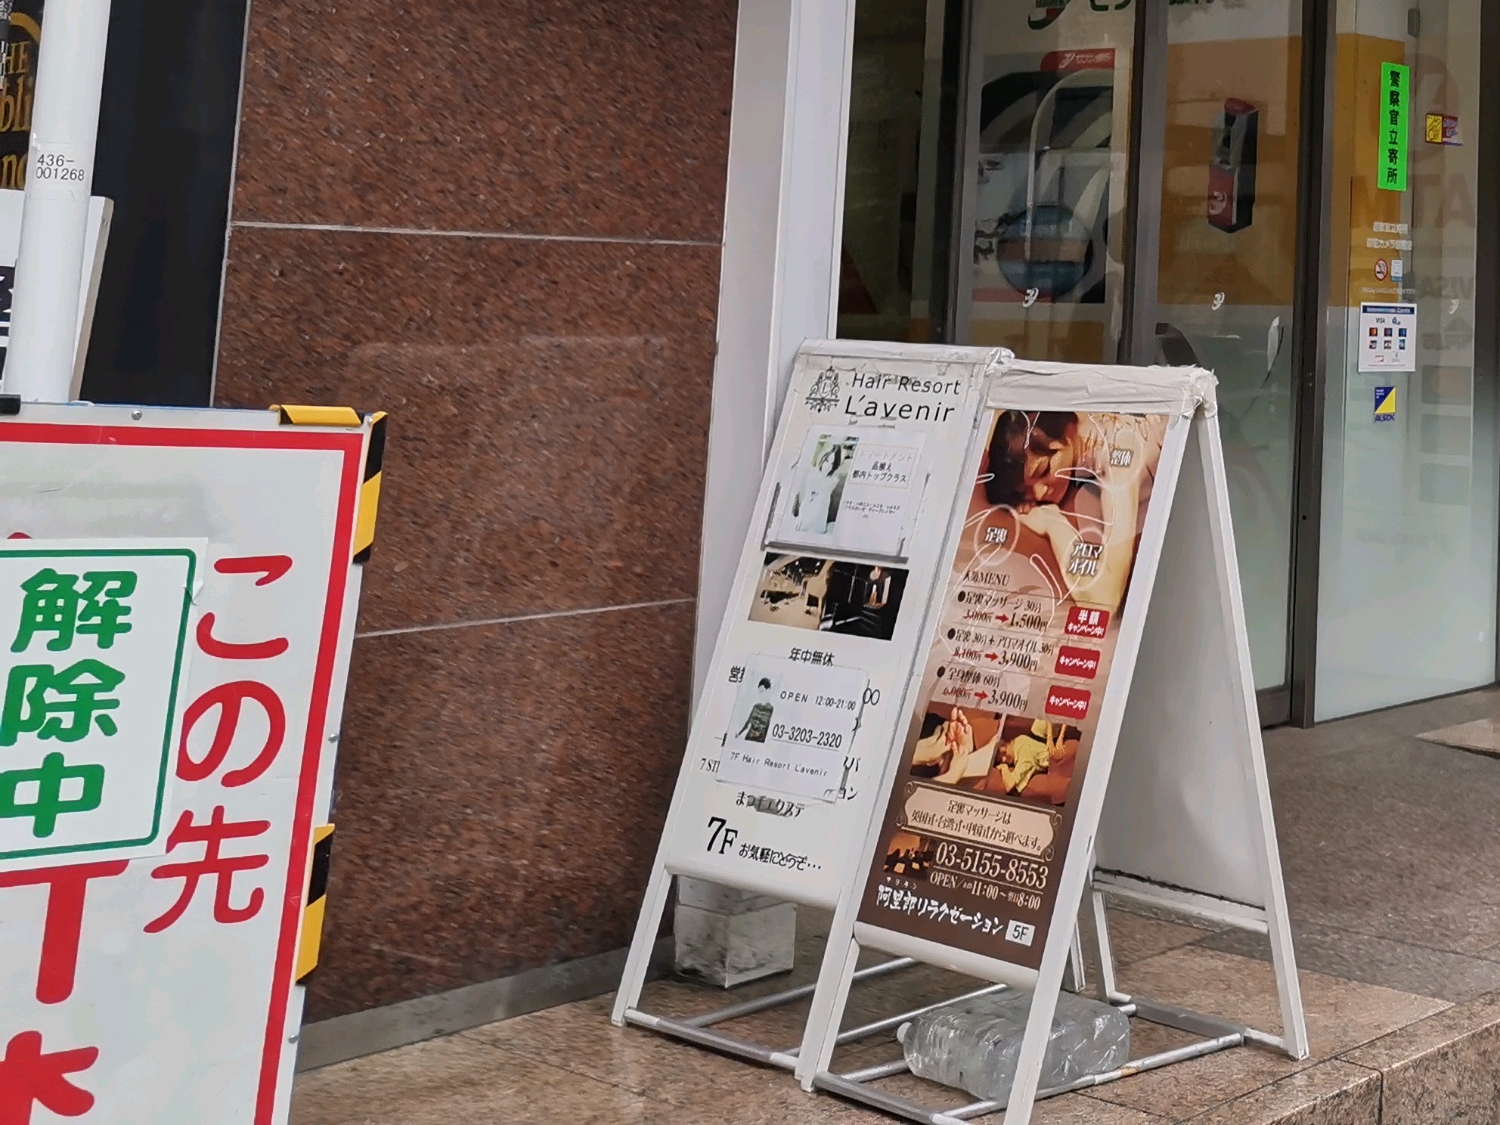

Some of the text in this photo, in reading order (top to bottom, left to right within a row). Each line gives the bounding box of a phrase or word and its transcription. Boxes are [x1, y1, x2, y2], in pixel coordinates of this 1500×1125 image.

[1385, 70, 1401, 185] 警察官立寄所
[37, 154, 75, 167] 436-
[35, 166, 85, 181] 001268
[852, 373, 961, 395] Hair Resort
[844, 395, 956, 422] L'avenir
[1072, 542, 1103, 557] アロマ
[1068, 559, 1098, 576] オイル
[1078, 609, 1100, 626] 半額
[788, 647, 835, 667] 年中無休
[0, 567, 138, 838] 解除中
[780, 691, 857, 711] OPEN 12:00-21:00
[143, 555, 293, 933] この先
[772, 723, 843, 749] 03-3203-2320
[742, 754, 761, 766] Hair
[764, 758, 791, 771] Resort
[706, 816, 739, 855] 7F
[935, 841, 1049, 889] 03-5155-8553
[876, 884, 1030, 941] 阿里郎リラクゼーション 5F
